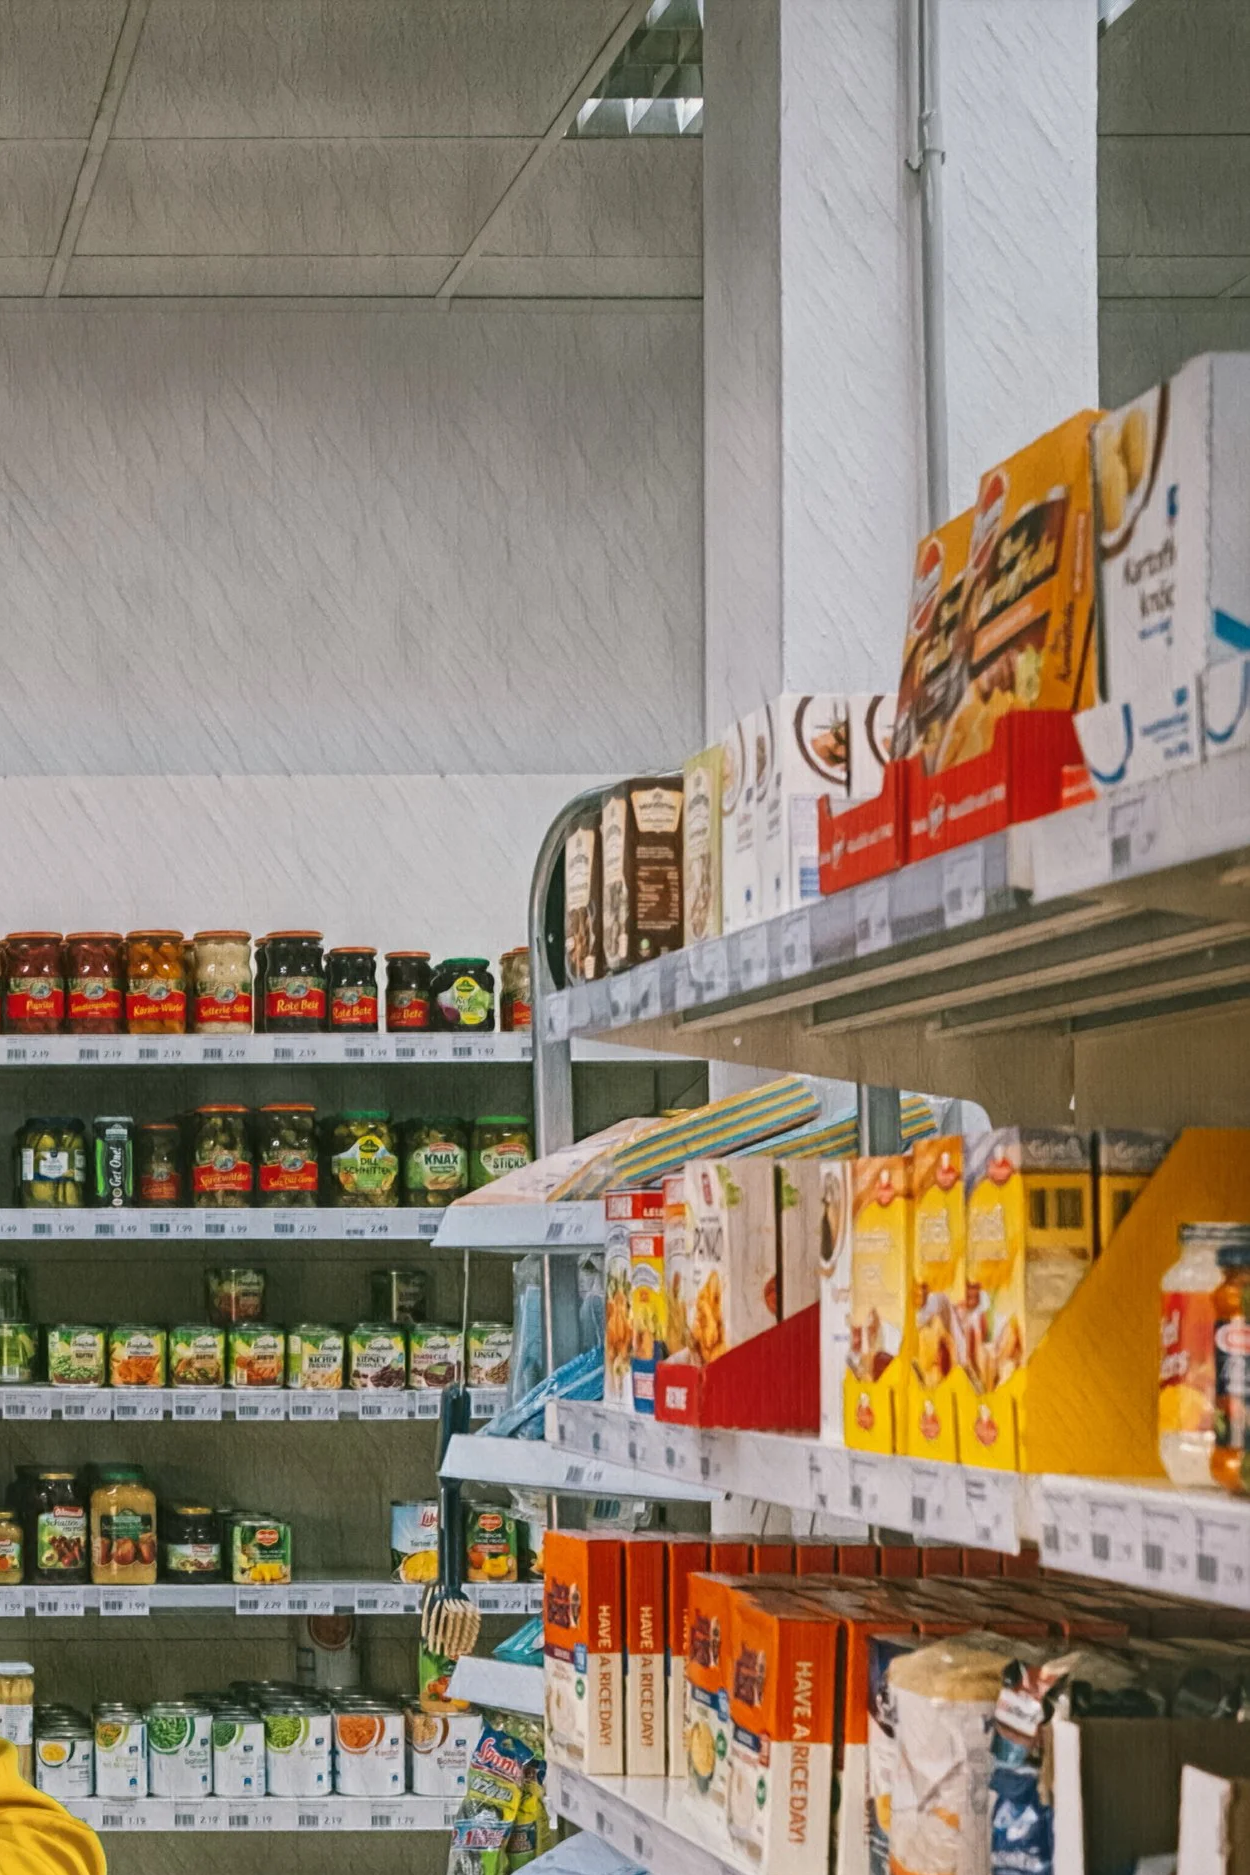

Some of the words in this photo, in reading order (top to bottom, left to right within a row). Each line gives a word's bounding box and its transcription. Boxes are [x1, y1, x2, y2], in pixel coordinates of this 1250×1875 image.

[360, 1157, 379, 1167] DILL
[424, 1153, 459, 1166] KNAX
[598, 1605, 612, 1649] HAVE
[640, 1606, 654, 1650] HAVE
[599, 1655, 612, 1668] A
[641, 1656, 654, 1669] A
[598, 1671, 613, 1707] RICE
[640, 1672, 655, 1708] RICE
[793, 1661, 813, 1719] HAVE
[599, 1710, 613, 1747] DAY!
[640, 1711, 654, 1748] DAY!
[791, 1724, 811, 1741] A
[789, 1745, 810, 1793] RICE
[788, 1795, 808, 1845] DAY!
